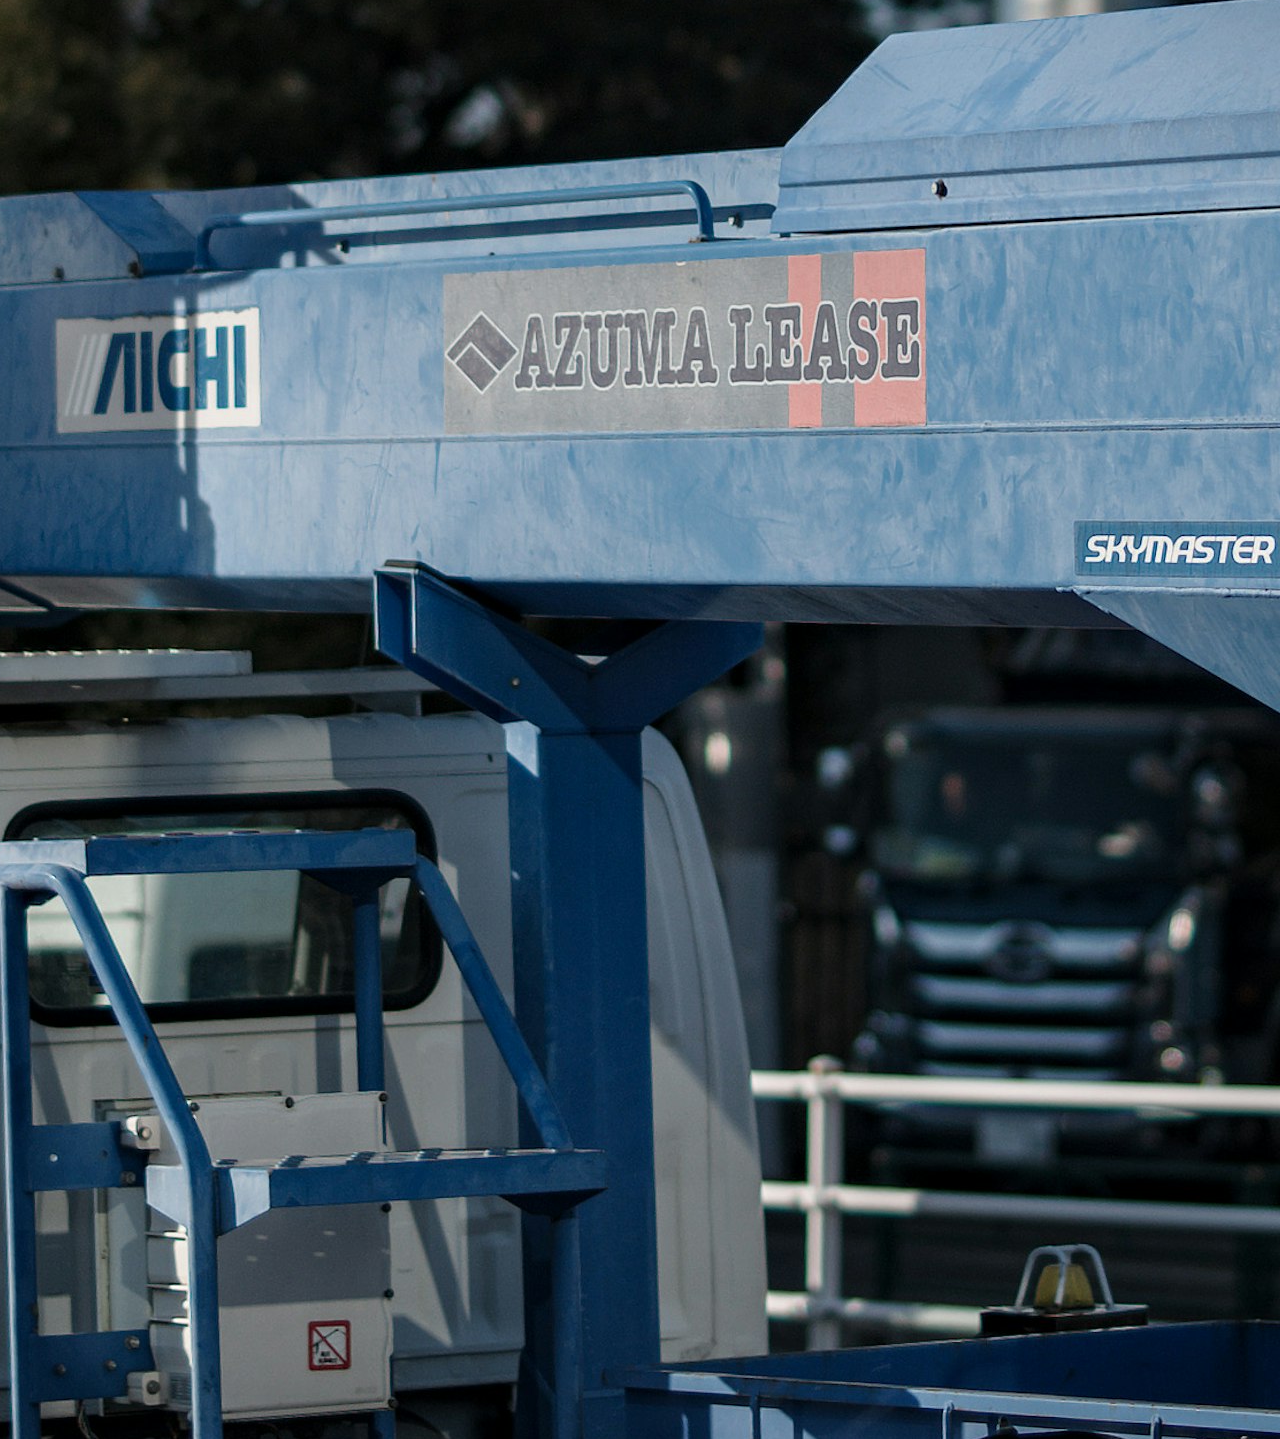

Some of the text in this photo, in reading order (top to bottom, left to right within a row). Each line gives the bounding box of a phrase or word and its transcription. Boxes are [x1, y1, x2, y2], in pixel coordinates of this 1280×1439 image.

[92, 323, 248, 416] AICHI
[514, 296, 922, 394] AZUMA LEASE
[1084, 533, 1276, 565] SKYMASTER
